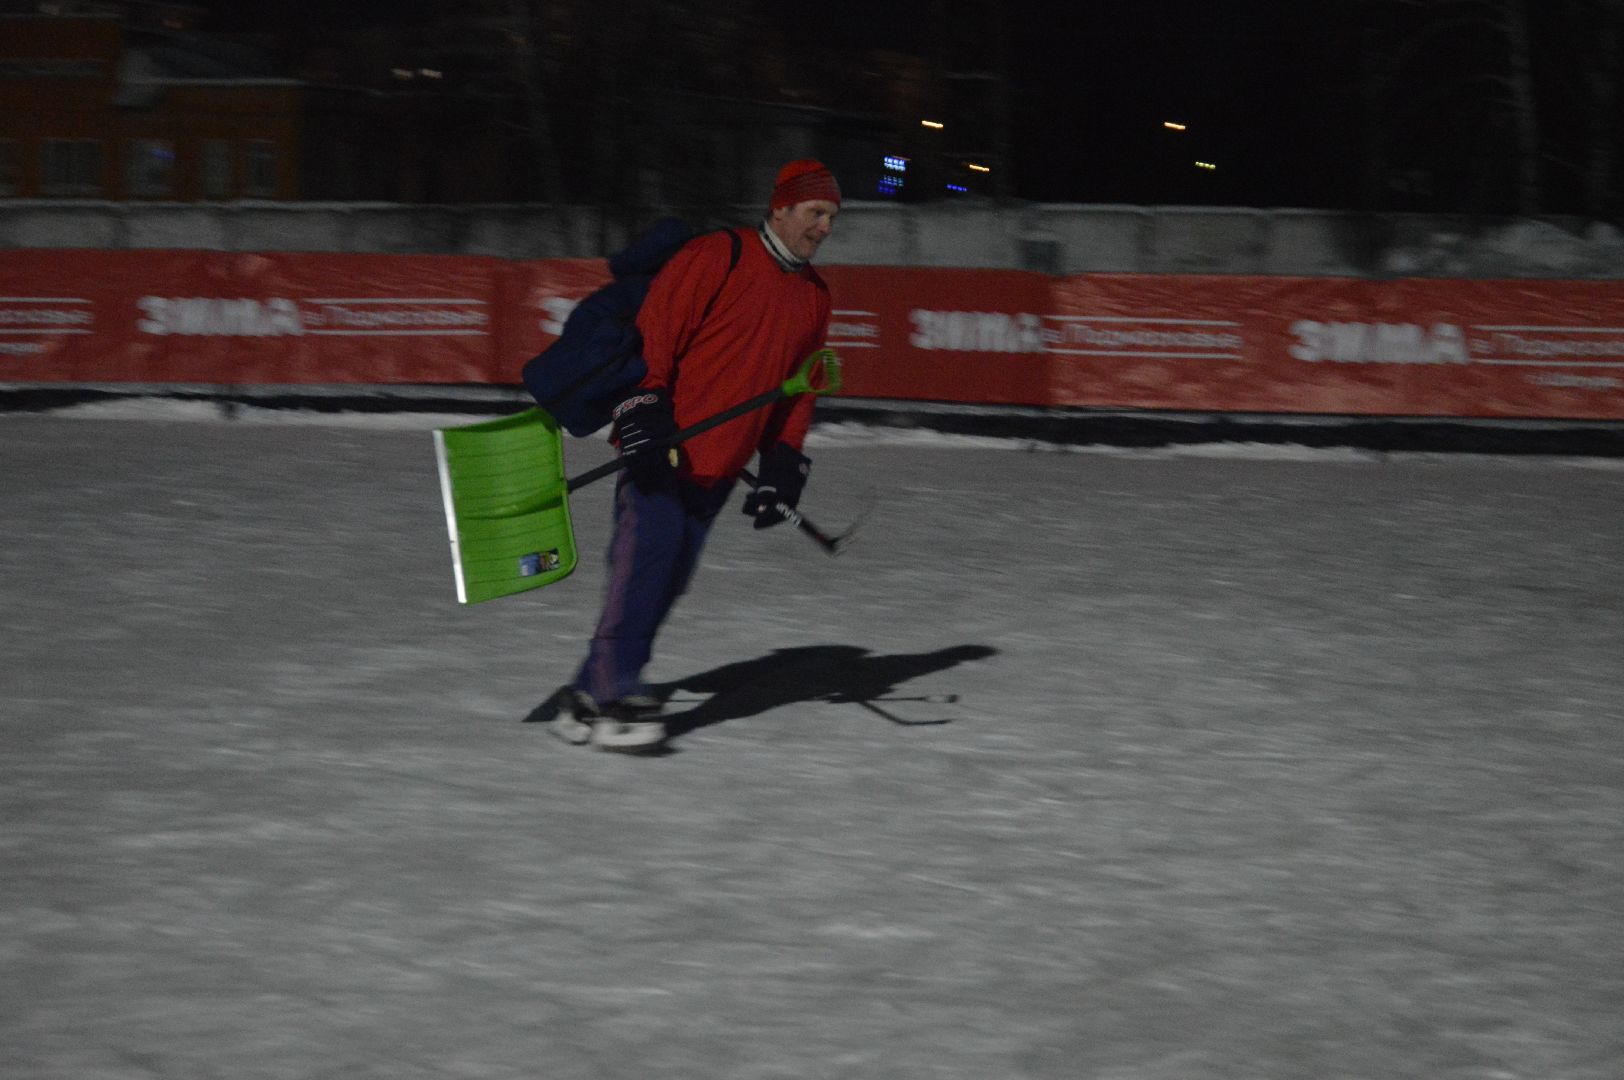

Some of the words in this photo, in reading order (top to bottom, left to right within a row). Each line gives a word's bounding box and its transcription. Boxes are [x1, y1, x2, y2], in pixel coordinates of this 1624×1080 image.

[137, 296, 303, 337] ЗИМА
[911, 308, 1042, 354] ЗИМА
[1290, 319, 1468, 365] ЗИМА
